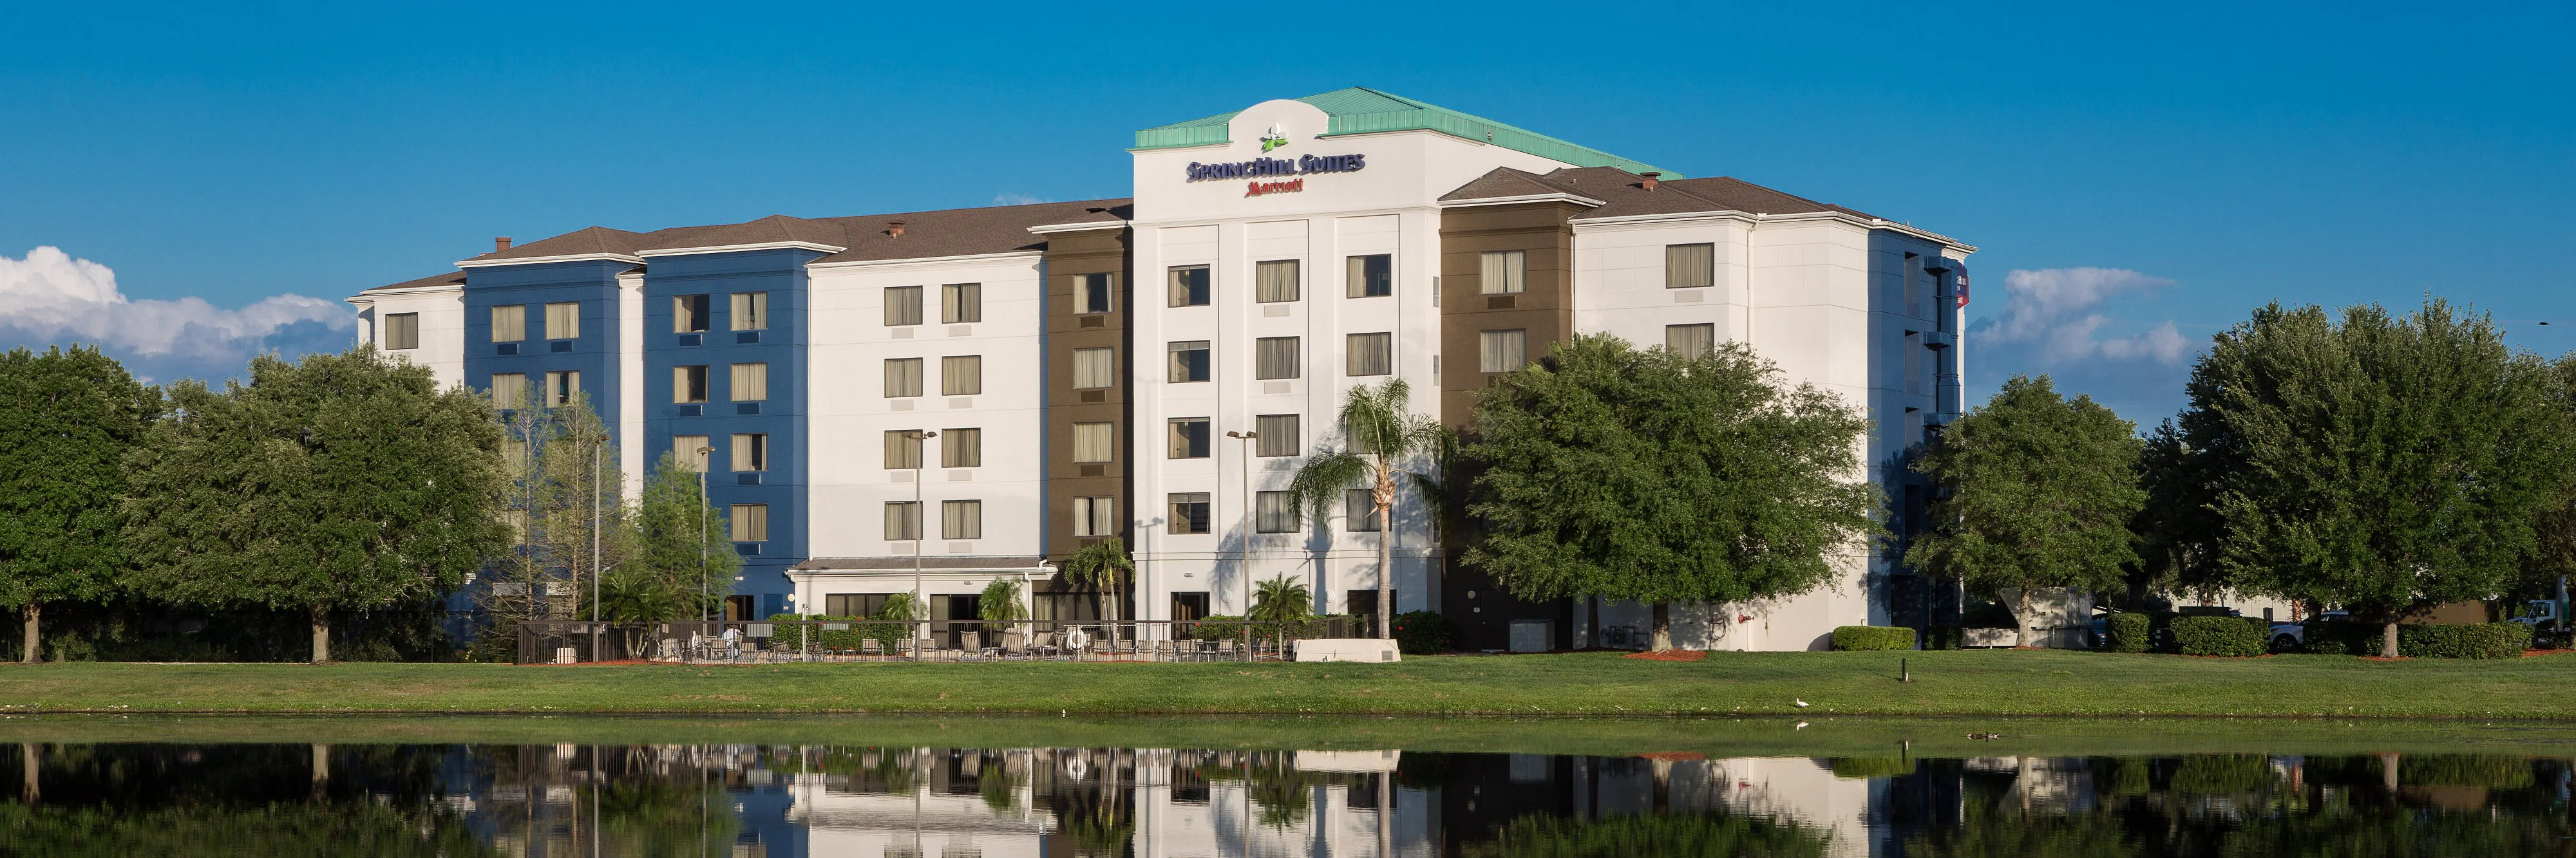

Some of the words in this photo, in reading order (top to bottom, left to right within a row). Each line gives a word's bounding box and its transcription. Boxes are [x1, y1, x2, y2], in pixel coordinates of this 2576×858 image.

[1186, 156, 1298, 181] SPRINGHILL
[1298, 153, 1365, 173] SUITES
[1245, 178, 1303, 196] Marriott
